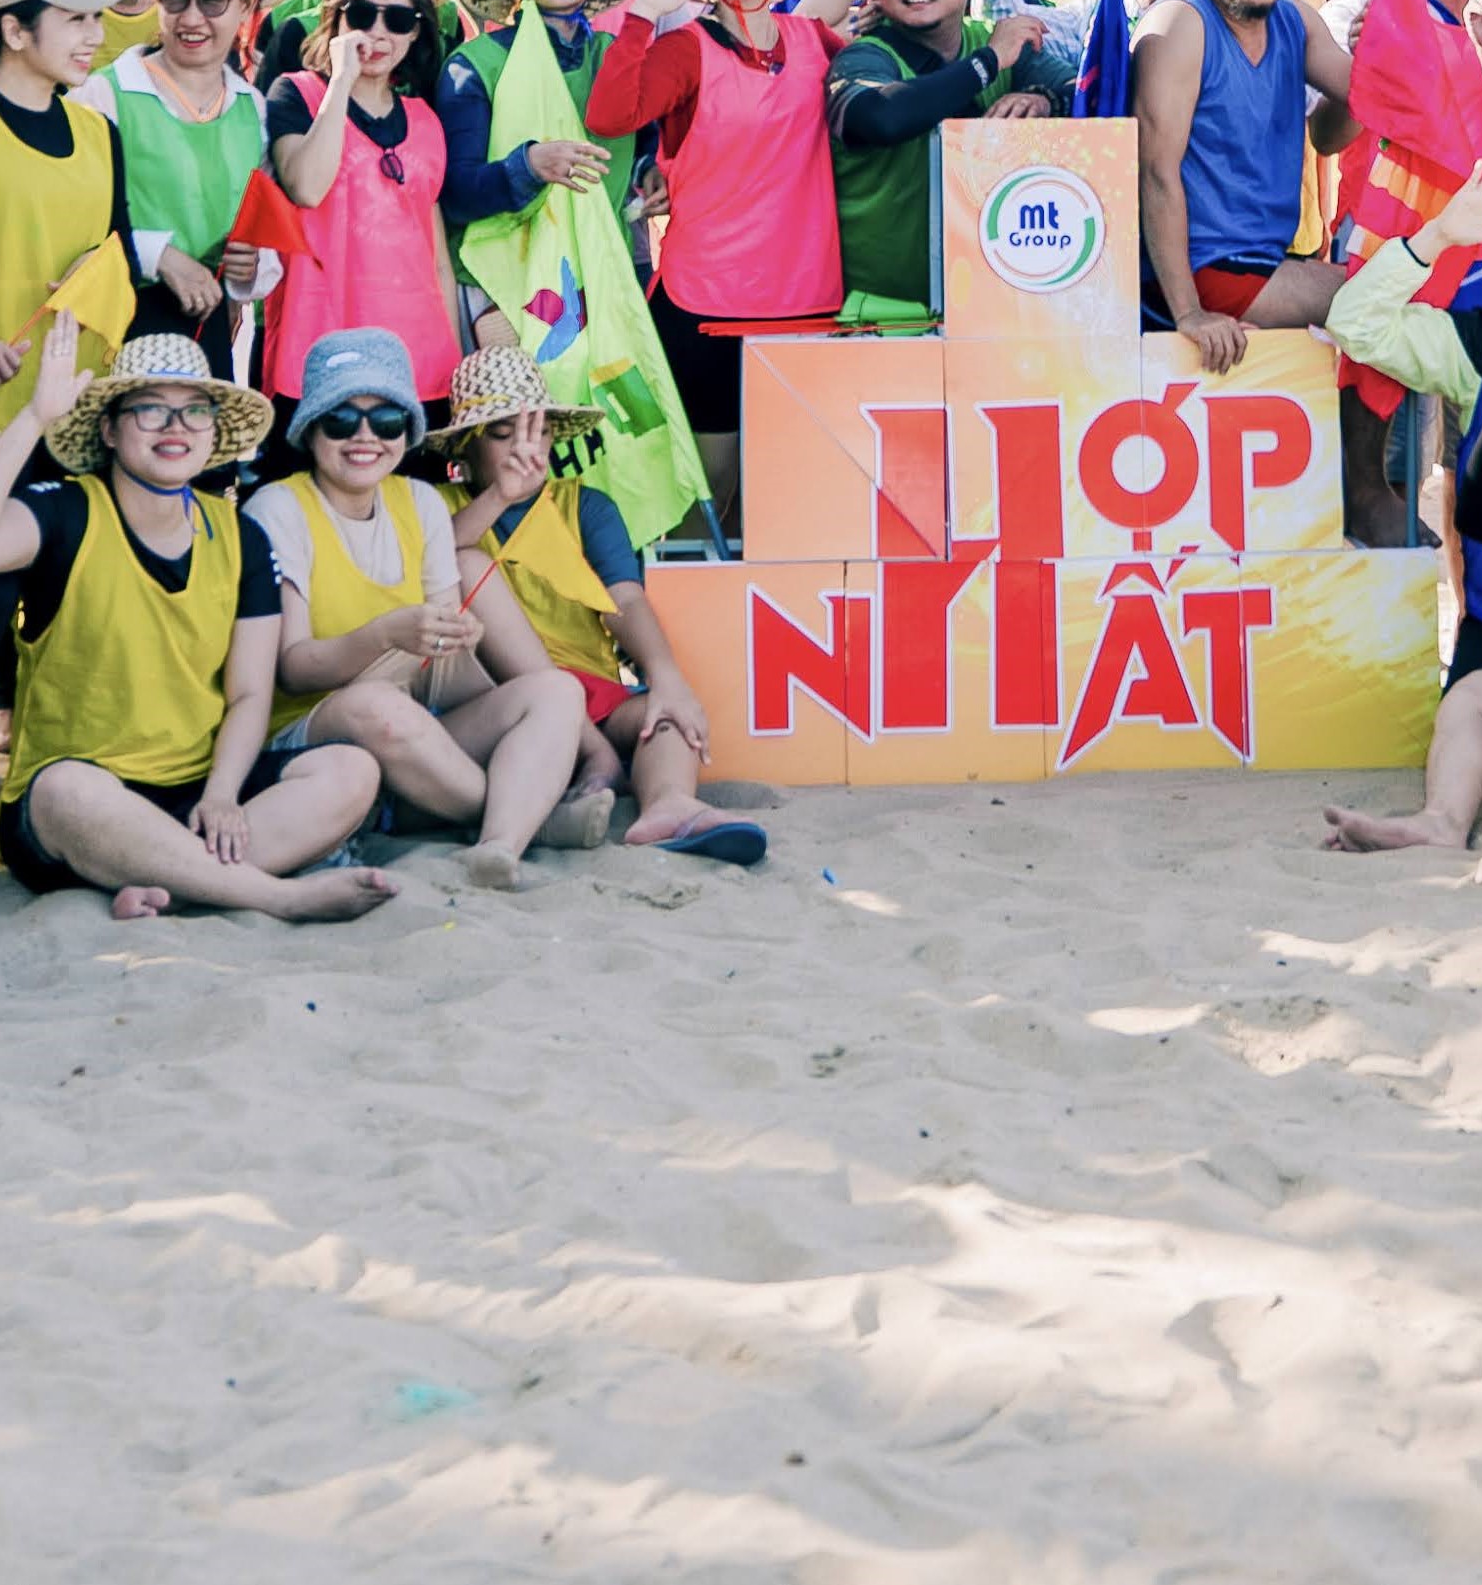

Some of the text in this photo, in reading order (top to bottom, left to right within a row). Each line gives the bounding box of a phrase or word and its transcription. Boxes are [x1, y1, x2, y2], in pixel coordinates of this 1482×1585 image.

[1009, 232, 1071, 250] Group
[1020, 201, 1060, 230] mt
[859, 380, 1315, 606] HỢP
[747, 511, 1277, 770] NHẤT
